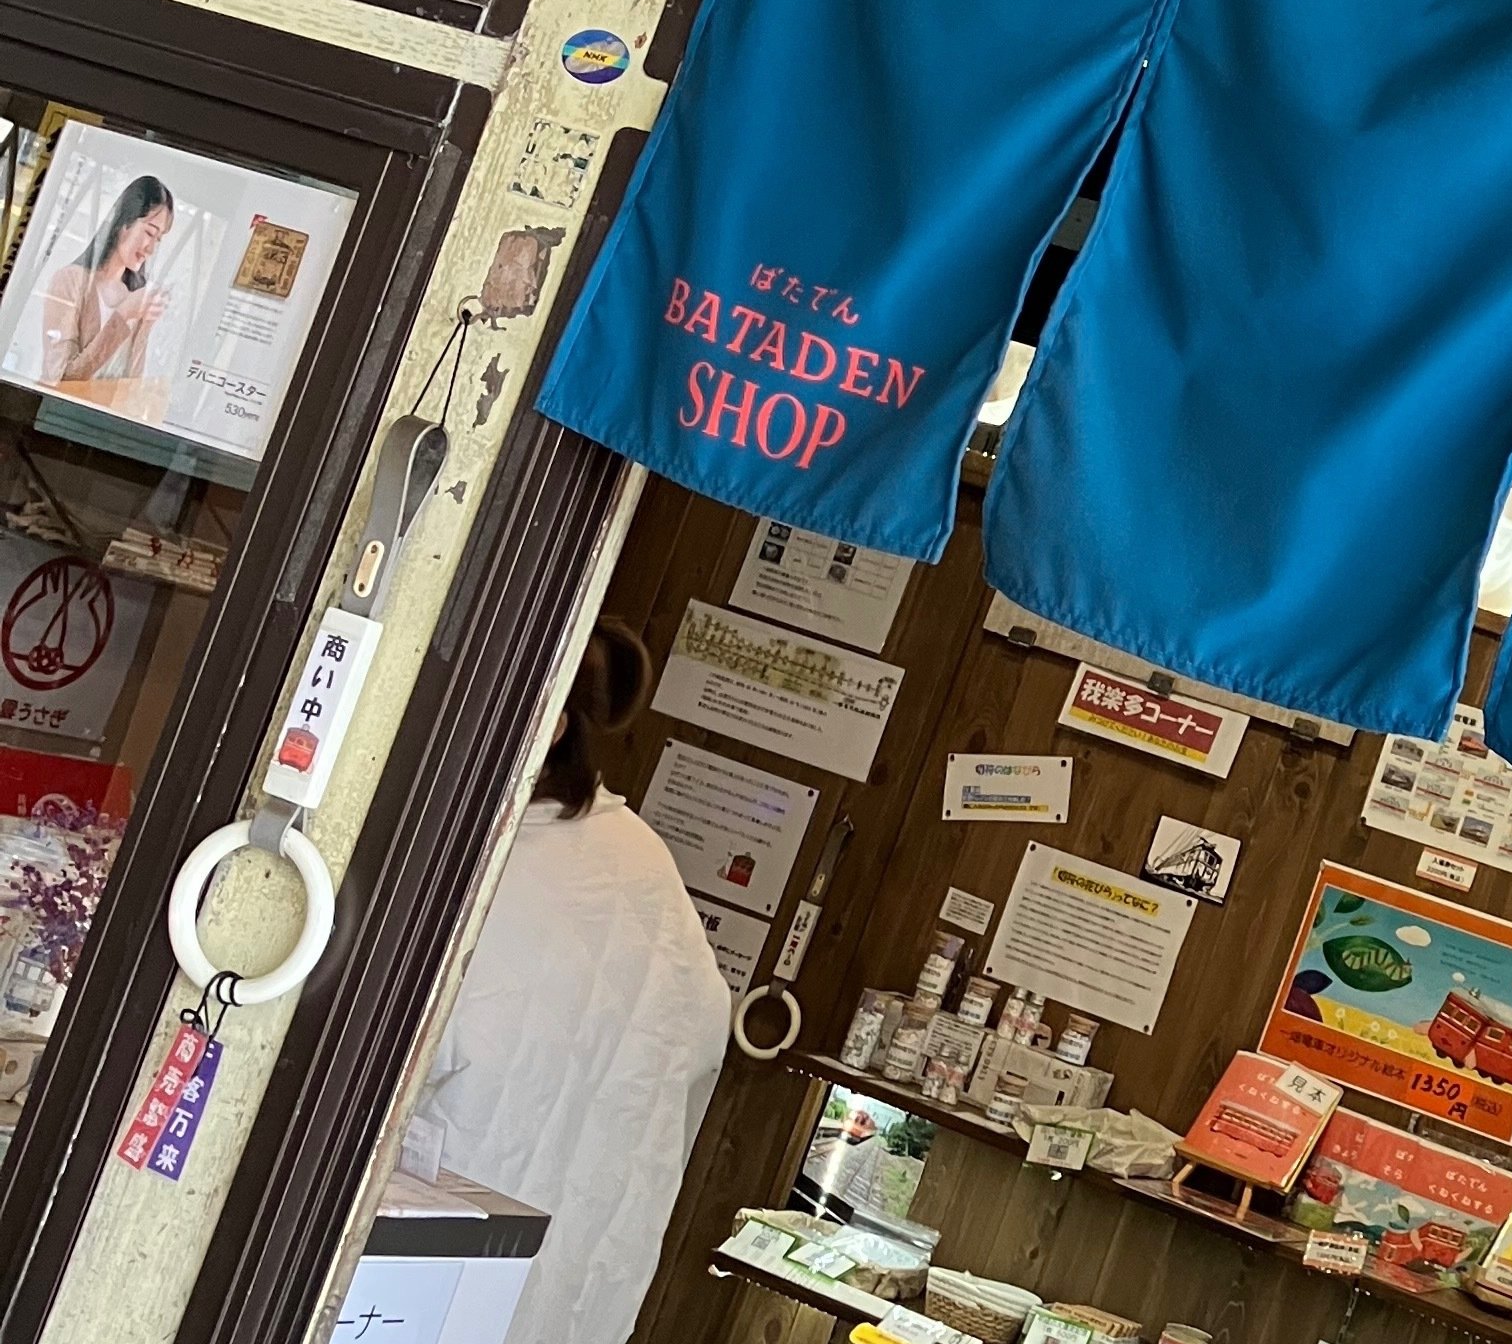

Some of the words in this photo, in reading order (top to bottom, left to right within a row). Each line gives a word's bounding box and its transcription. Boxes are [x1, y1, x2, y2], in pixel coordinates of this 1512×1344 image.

[582, 50, 608, 62] NHK
[751, 263, 859, 324] ばたでん
[664, 277, 925, 409] BATADEN
[680, 361, 846, 469] SHOP
[300, 633, 350, 723] 商い中
[1081, 678, 1213, 735] 我楽多コーナー
[1287, 1073, 1327, 1104] 見本
[1409, 1070, 1461, 1102] 1350
[1447, 1100, 1468, 1120] 円
[1427, 1182, 1494, 1215] くねくねする
[1444, 1168, 1489, 1193] ばたでん
